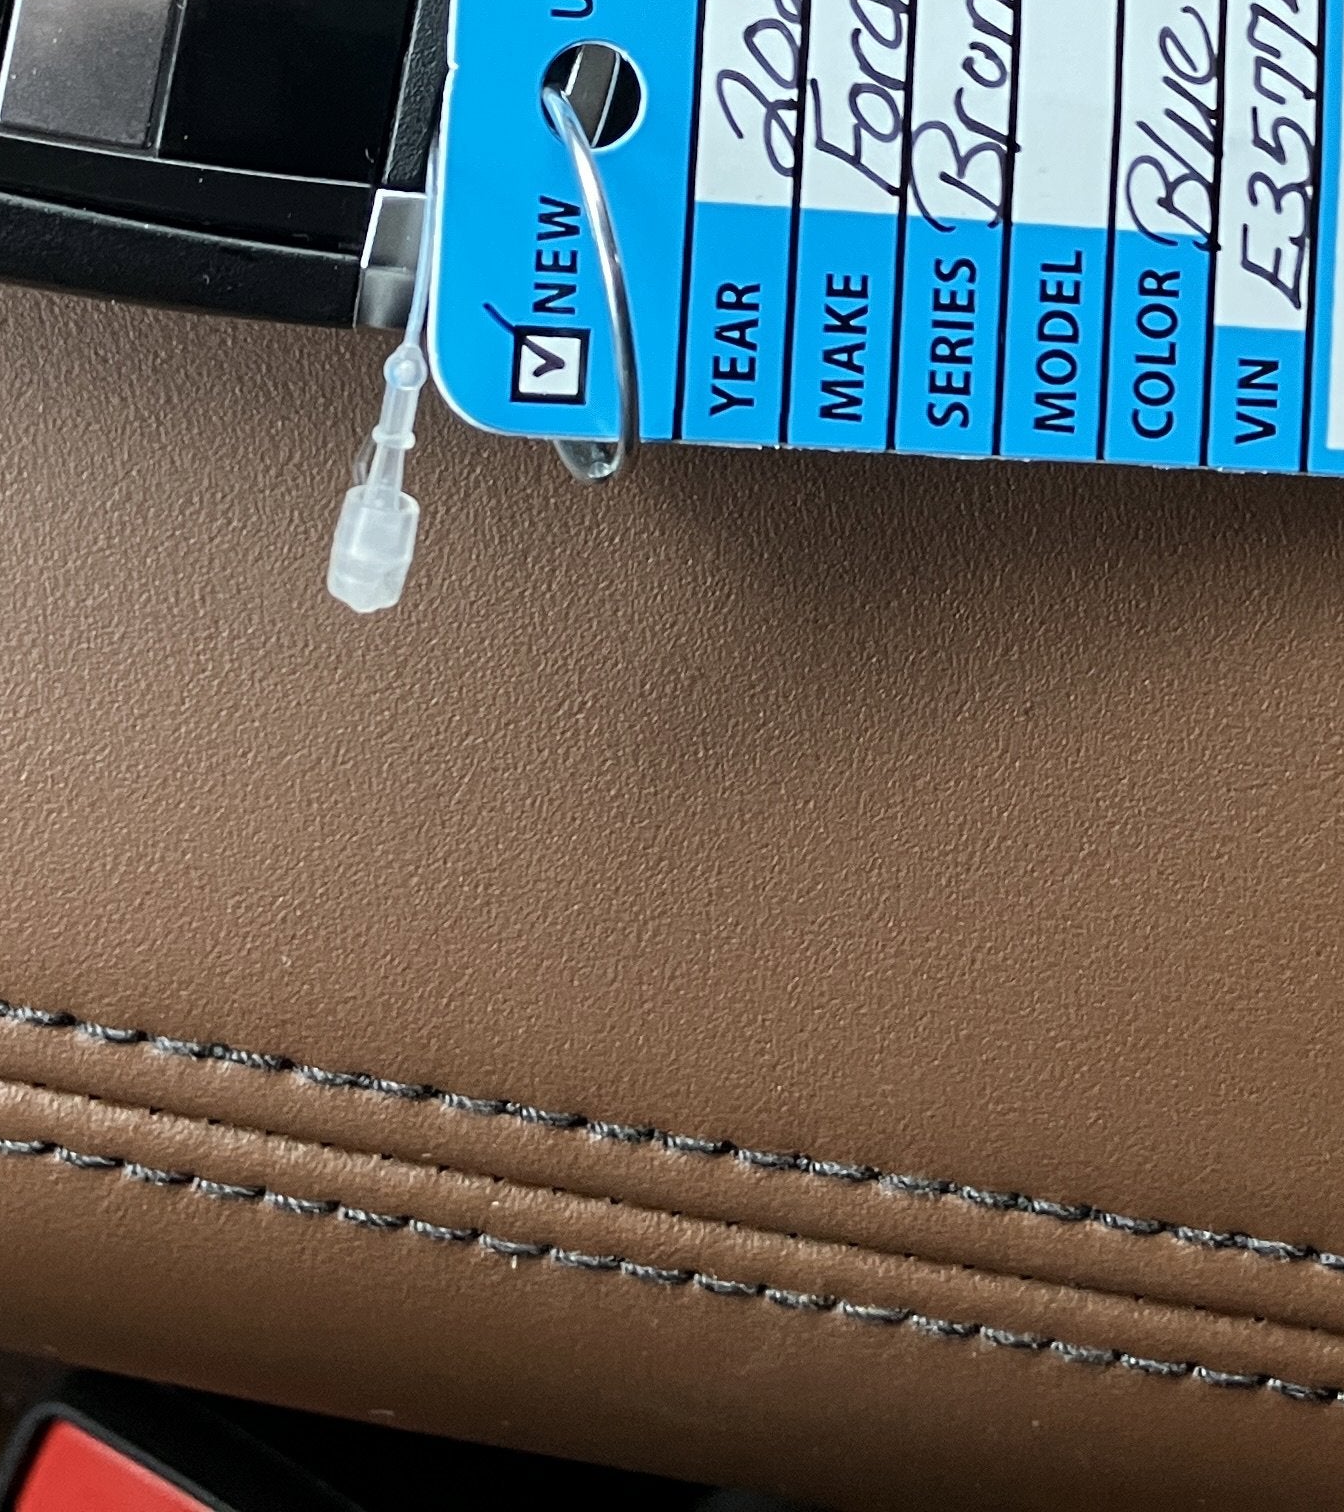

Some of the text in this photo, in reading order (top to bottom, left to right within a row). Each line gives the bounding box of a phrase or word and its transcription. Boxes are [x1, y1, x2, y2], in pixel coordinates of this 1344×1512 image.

[1122, 5, 1224, 253] Blue
[532, 196, 584, 316] NEW
[708, 281, 762, 416] YEAR
[818, 272, 870, 422] MAKE
[928, 256, 978, 429] SERIES
[1032, 250, 1086, 435] MODEL
[1130, 265, 1182, 440] COLOR
[1232, 356, 1281, 444] VIN
